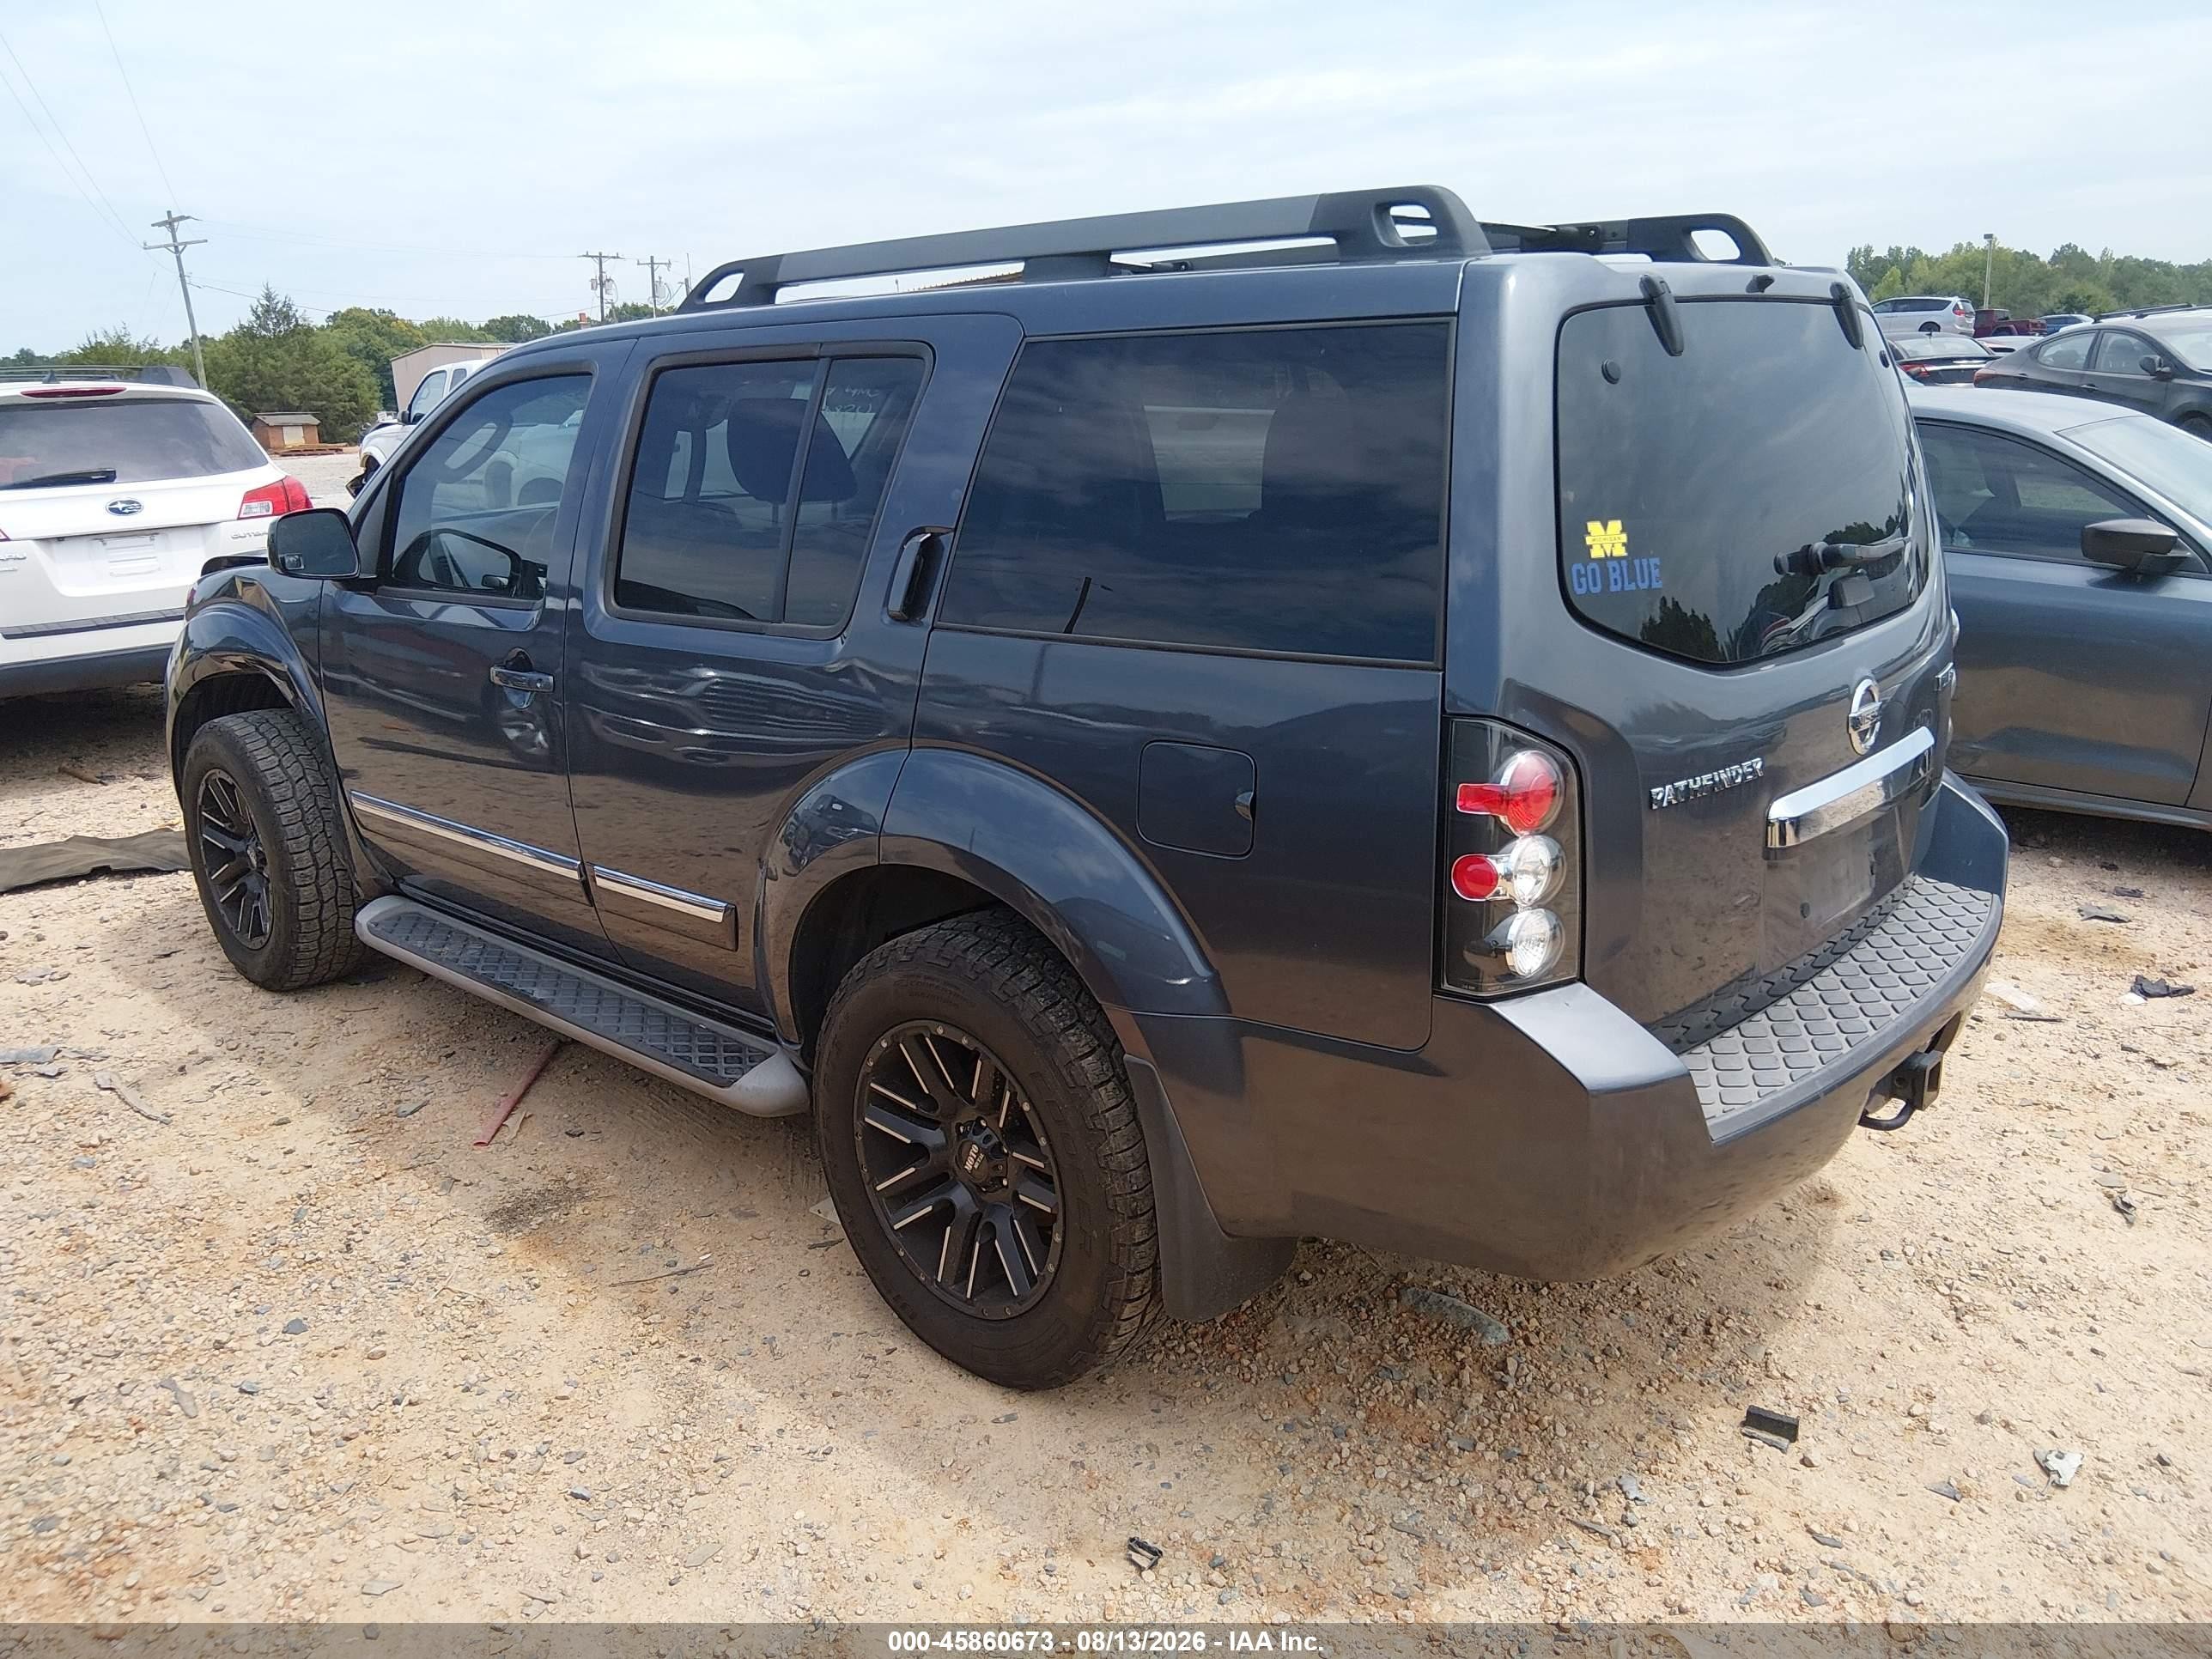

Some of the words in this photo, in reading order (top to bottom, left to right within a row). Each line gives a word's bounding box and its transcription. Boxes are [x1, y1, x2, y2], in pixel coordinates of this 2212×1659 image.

[1571, 562, 1601, 595] GO
[1606, 557, 1662, 592] BLUE
[1650, 757, 1765, 810] PATHFINDER
[963, 1144, 979, 1174] MOTO
